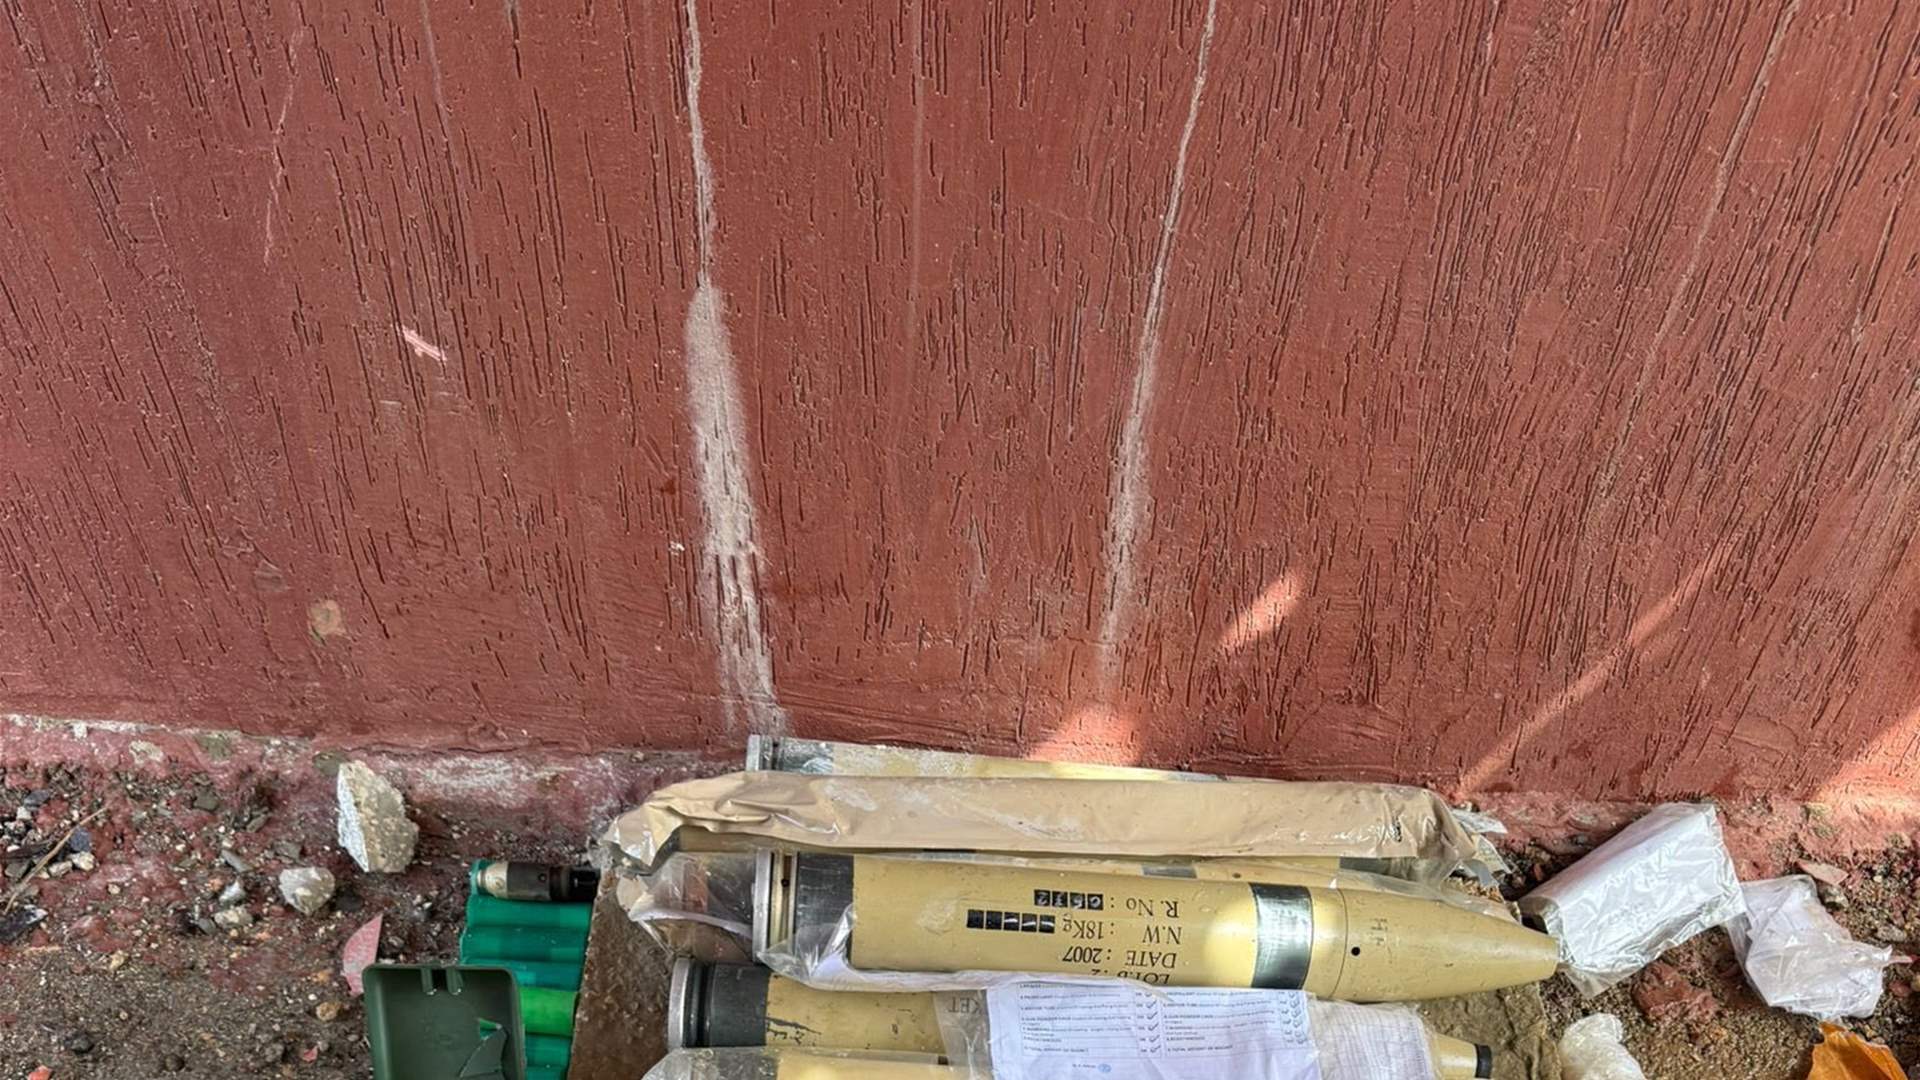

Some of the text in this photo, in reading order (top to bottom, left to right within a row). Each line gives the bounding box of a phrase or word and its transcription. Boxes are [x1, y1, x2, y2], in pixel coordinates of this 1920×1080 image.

[1126, 898, 1154, 917] No
[1062, 913, 1104, 939] 18Kg
[1142, 925, 1182, 945] N.W
[1062, 946, 1102, 964] 2007
[1124, 950, 1177, 968] DATE
